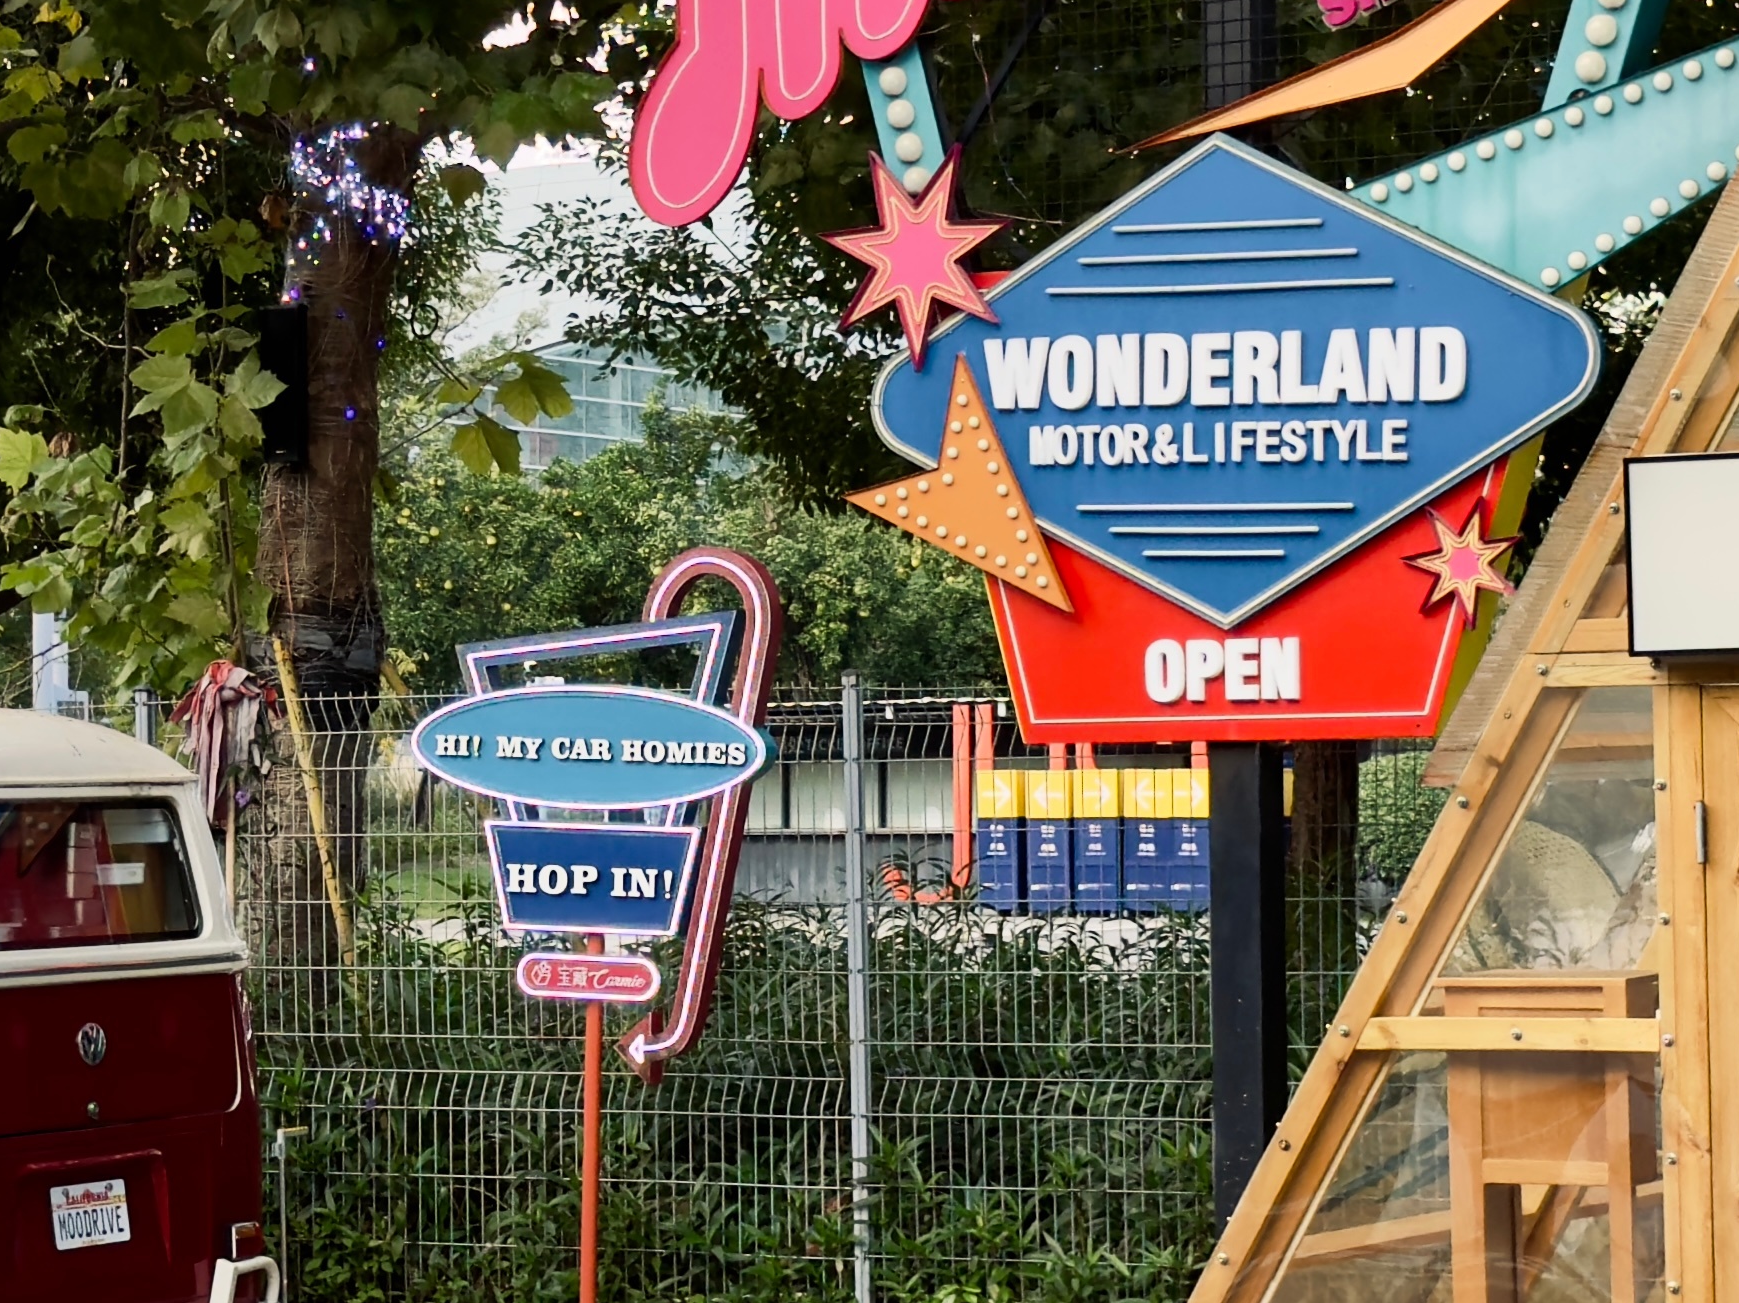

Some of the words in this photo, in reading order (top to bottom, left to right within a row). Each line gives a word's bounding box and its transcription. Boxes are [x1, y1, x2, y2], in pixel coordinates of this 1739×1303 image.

[982, 326, 1467, 411] WONDERLAND
[1029, 418, 1408, 465] MOTOR&LIFESTYLE
[1144, 636, 1301, 704] OPEN
[435, 734, 481, 757] HI!
[496, 736, 543, 759] MY
[551, 737, 612, 761] CAR
[621, 740, 747, 766] HOMIES
[506, 863, 598, 895] HOP
[610, 867, 673, 899] IN!
[58, 1205, 125, 1241] MOODRIVE
